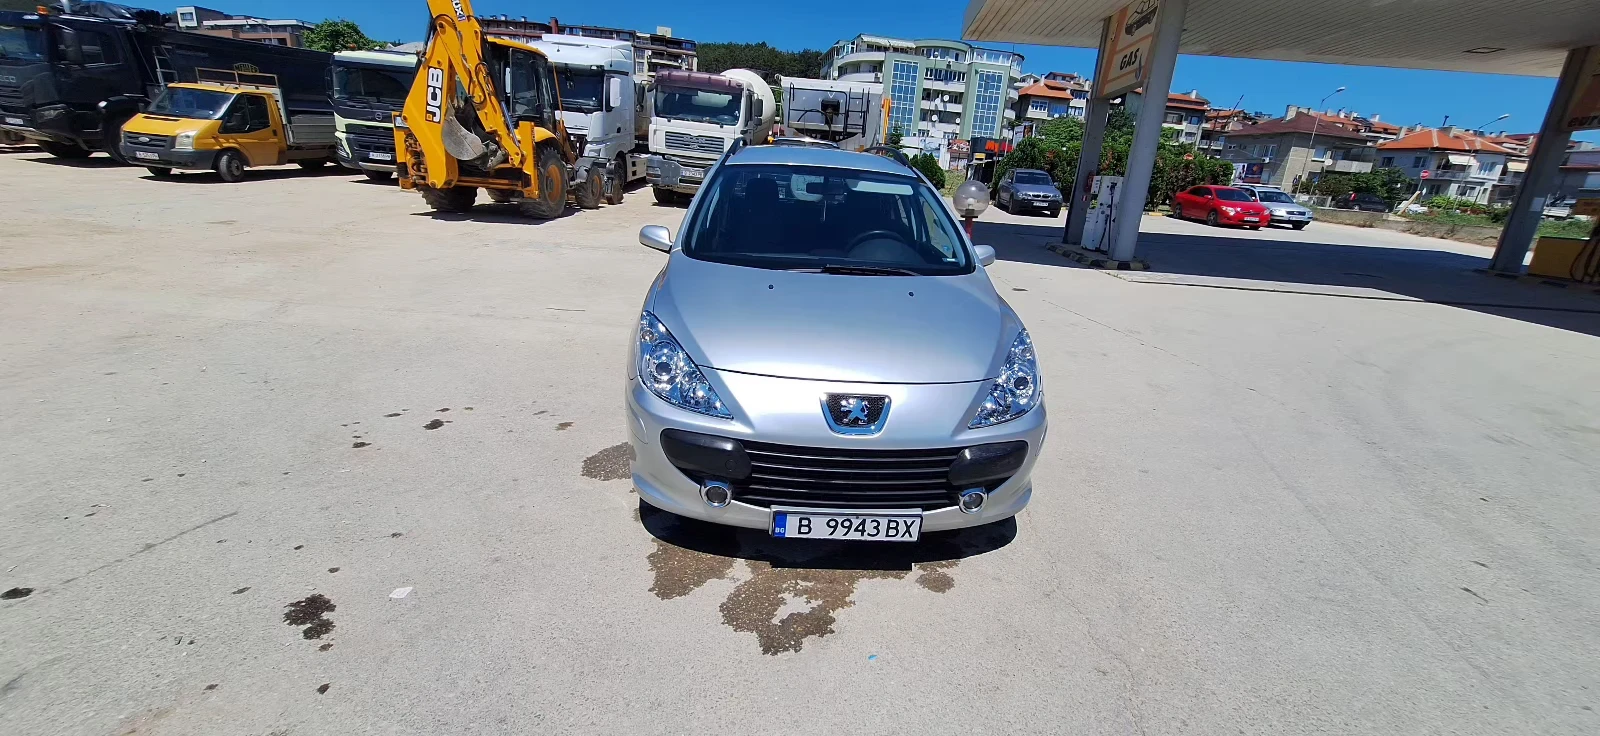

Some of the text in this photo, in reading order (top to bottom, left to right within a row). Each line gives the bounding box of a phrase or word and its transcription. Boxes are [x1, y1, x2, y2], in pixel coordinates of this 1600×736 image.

[1120, 47, 1140, 71] GAS
[427, 67, 443, 122] JCB
[1567, 114, 1600, 128] eur
[797, 517, 812, 535] B
[826, 518, 880, 537] 9943
[885, 519, 916, 538] BX
